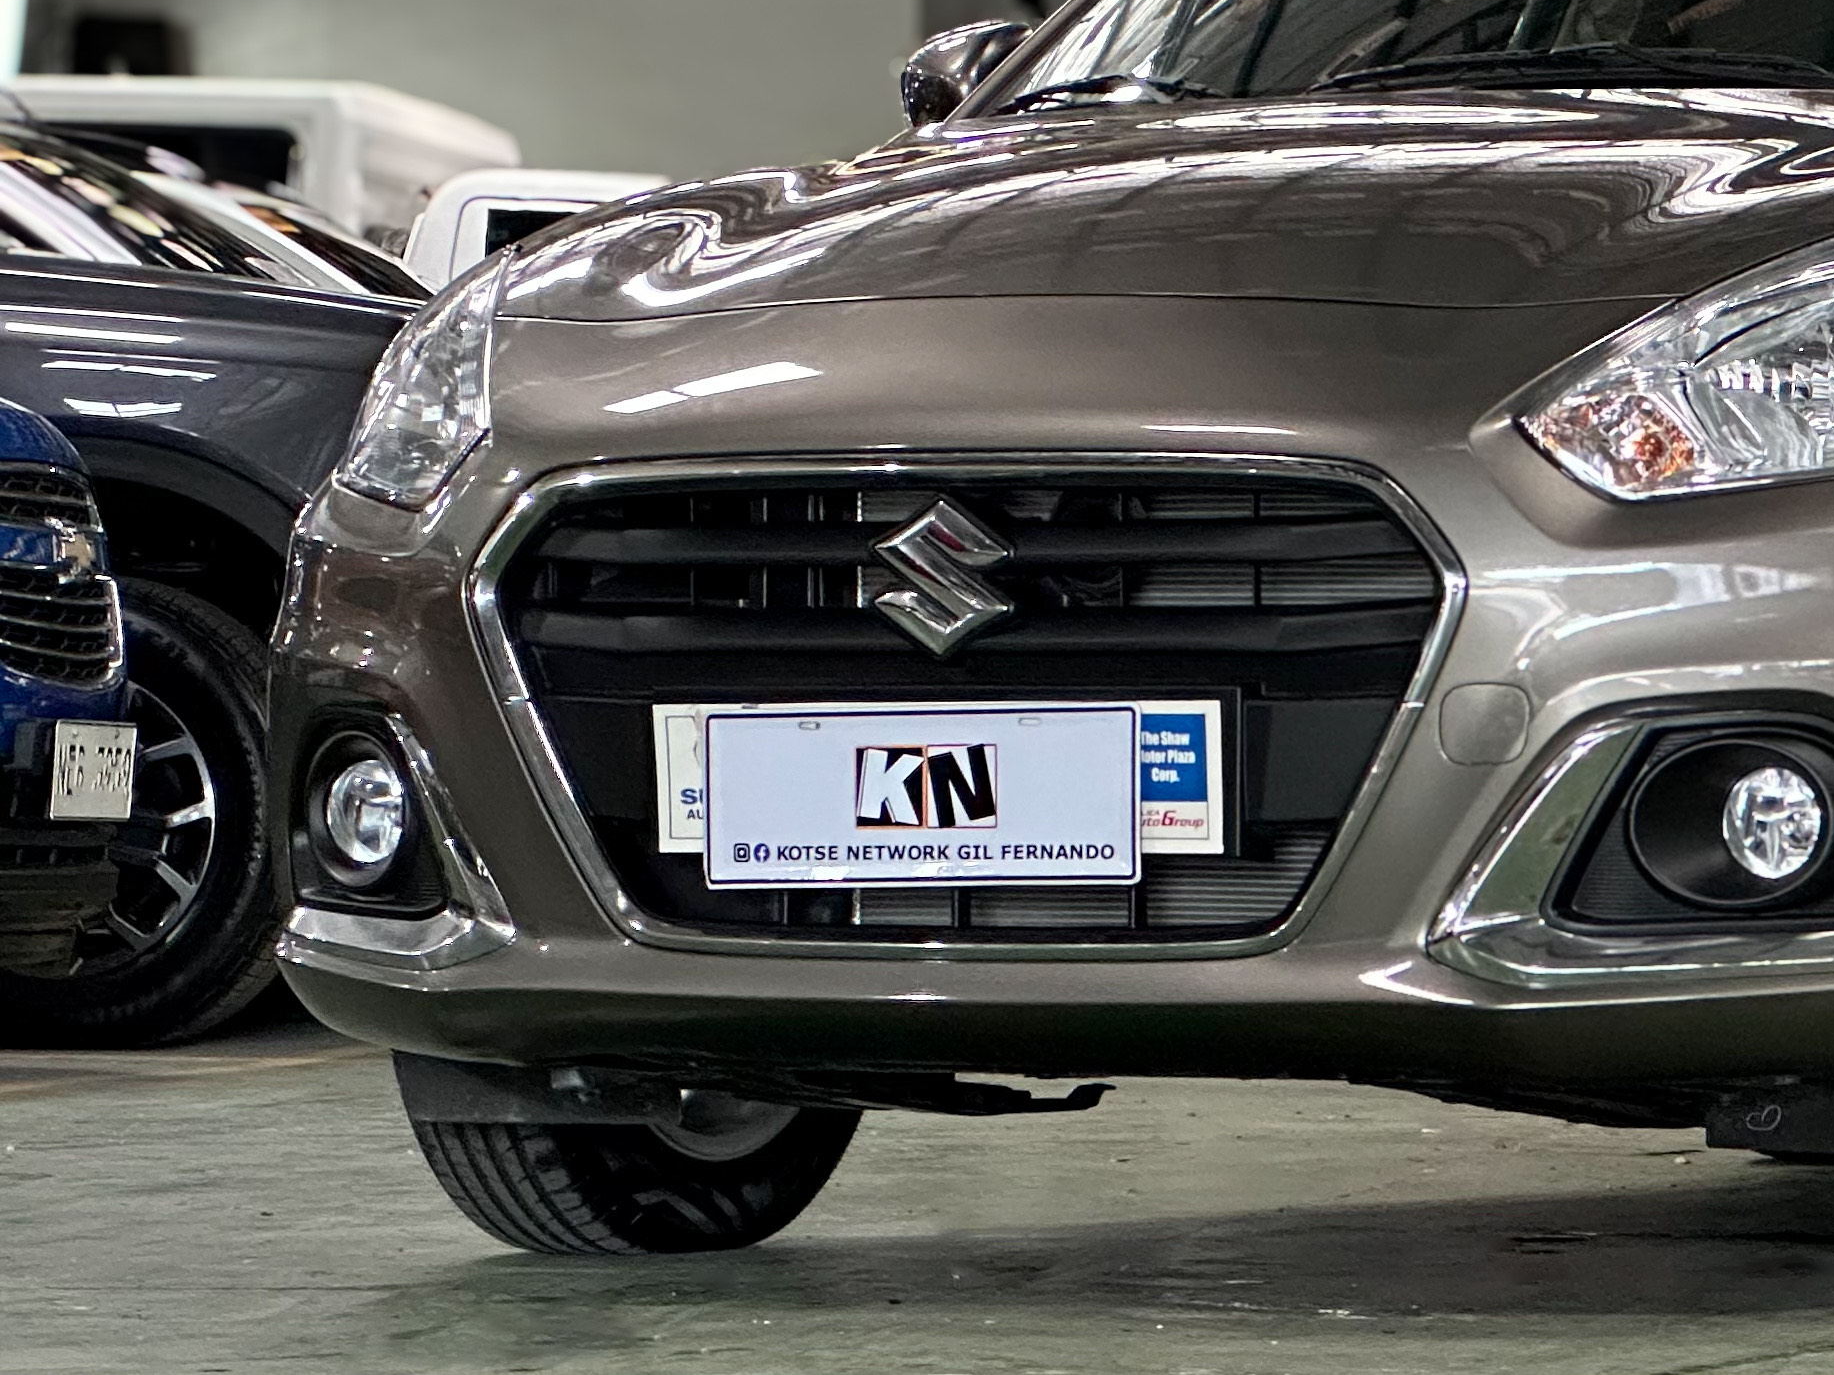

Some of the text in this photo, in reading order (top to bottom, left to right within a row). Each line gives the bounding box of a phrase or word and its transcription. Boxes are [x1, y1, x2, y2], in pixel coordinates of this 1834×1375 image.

[1160, 730, 1191, 745] Shaw
[1166, 749, 1196, 764] Plaza
[1151, 766, 1181, 784] Corp.
[777, 844, 1115, 861] KOTSE NETWORK GIL FERNANDO
